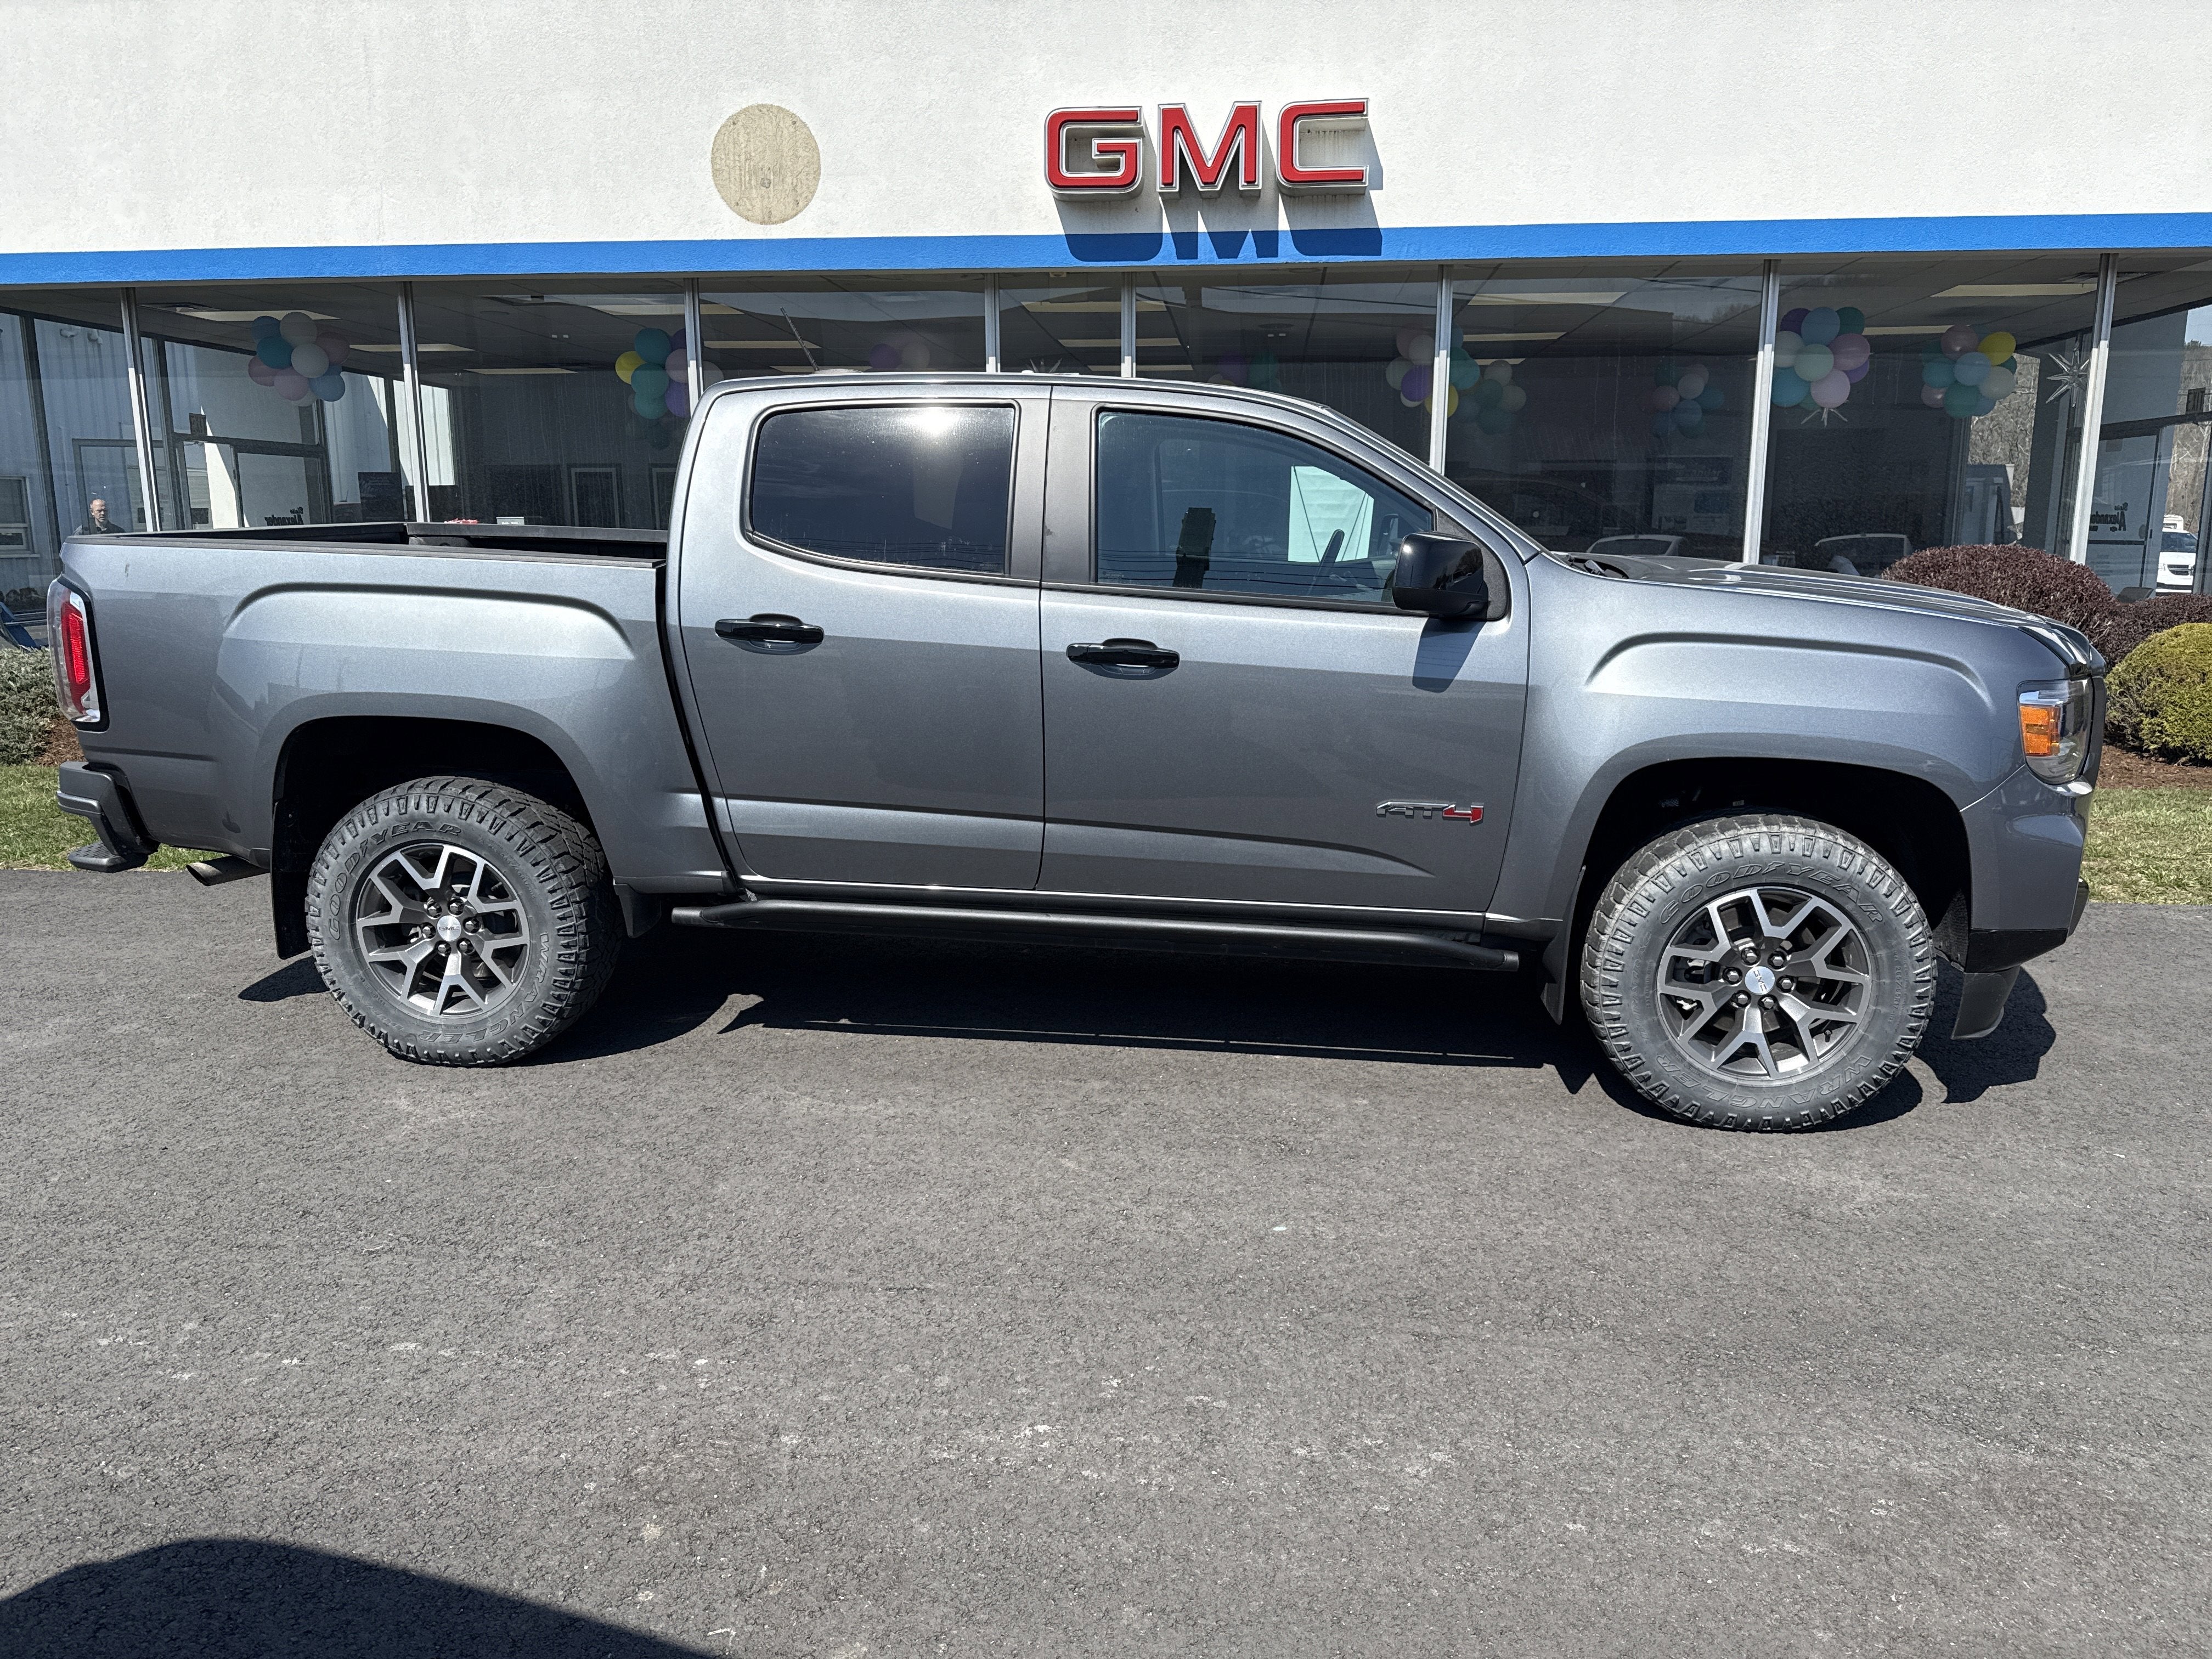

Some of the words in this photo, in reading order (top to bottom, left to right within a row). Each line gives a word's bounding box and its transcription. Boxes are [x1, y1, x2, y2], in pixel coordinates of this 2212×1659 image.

[1044, 98, 1369, 194] GMC
[1376, 801, 1484, 823] AT4
[329, 821, 462, 940] GOODYEAR
[1661, 861, 1883, 924] GOODYEAR
[418, 932, 549, 1044] WRANGLER
[1753, 969, 1768, 992] GMC
[1656, 1054, 1872, 1109] WRANGLER
